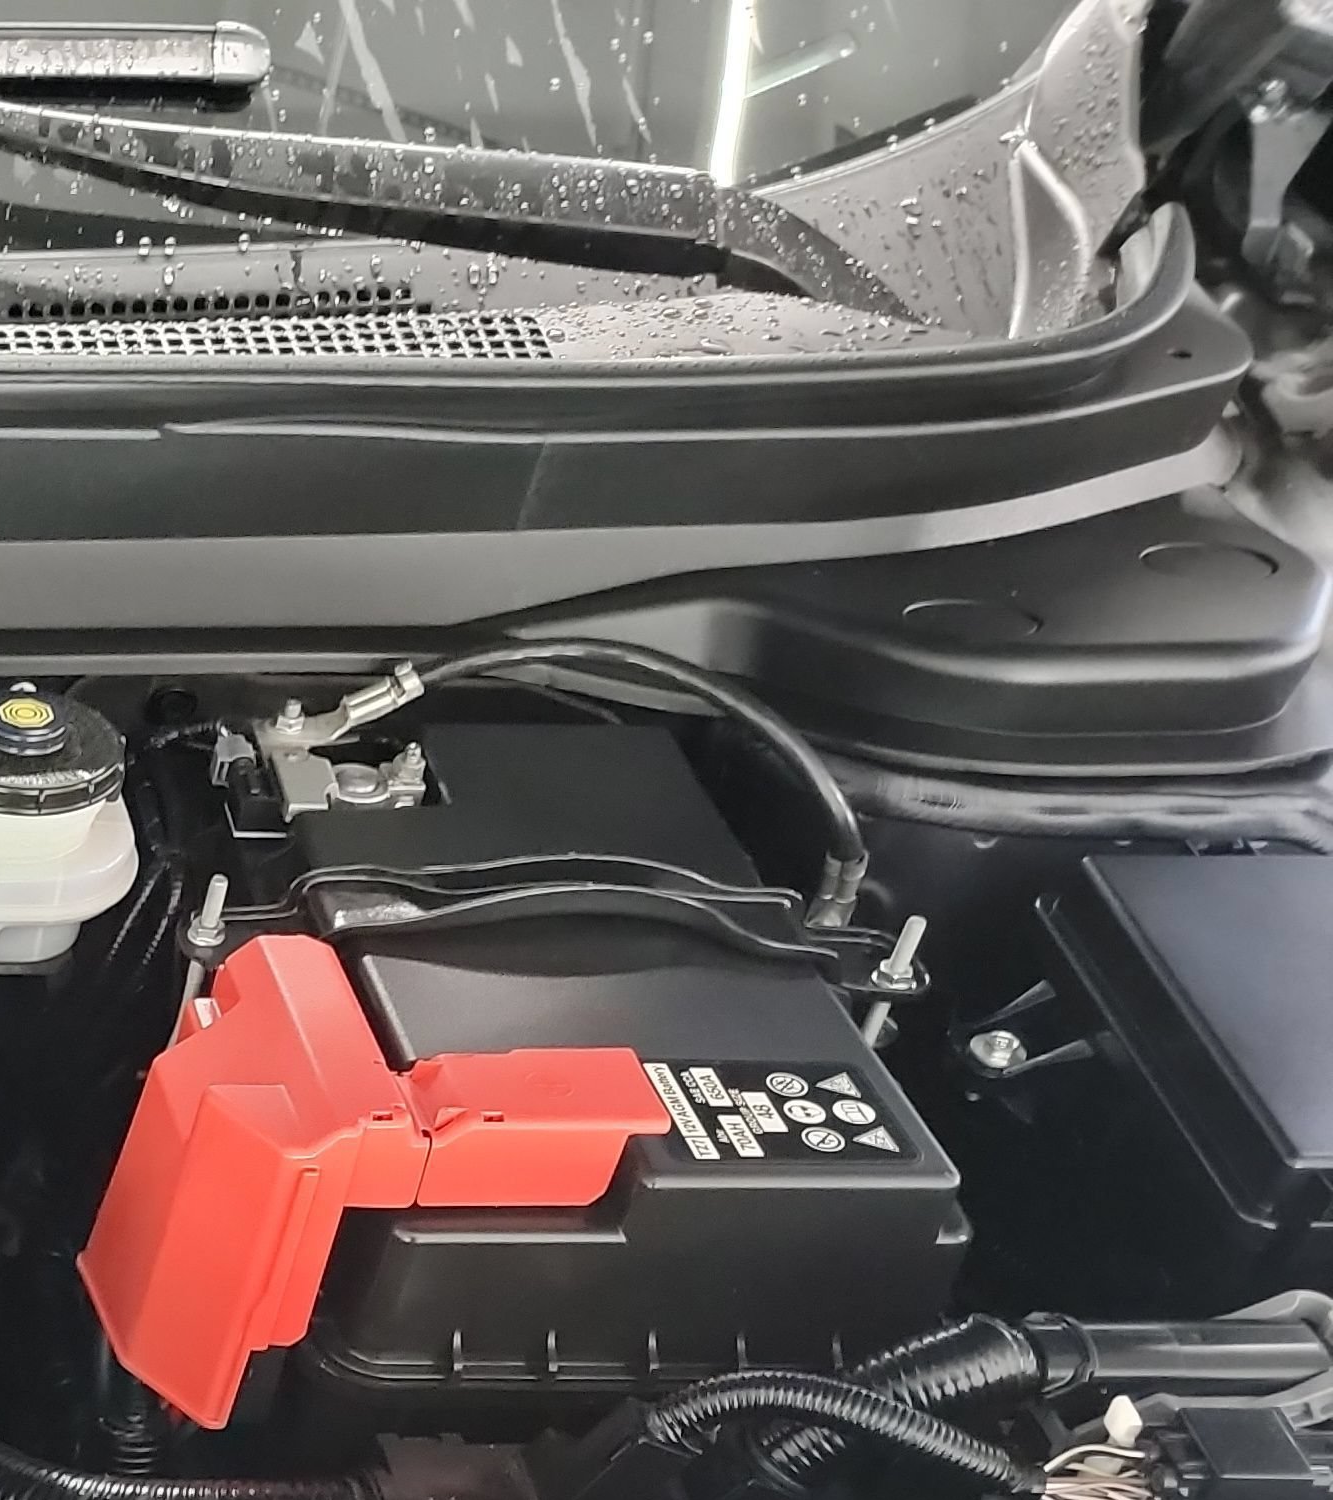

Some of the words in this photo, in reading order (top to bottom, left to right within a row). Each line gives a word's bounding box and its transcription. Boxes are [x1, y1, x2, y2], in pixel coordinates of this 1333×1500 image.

[653, 1066, 674, 1096] Battery
[699, 1074, 725, 1100] 650A
[667, 1096, 690, 1118] AGM
[753, 1104, 774, 1119] 48
[678, 1118, 699, 1133] 12V
[726, 1122, 756, 1151] 70AH
